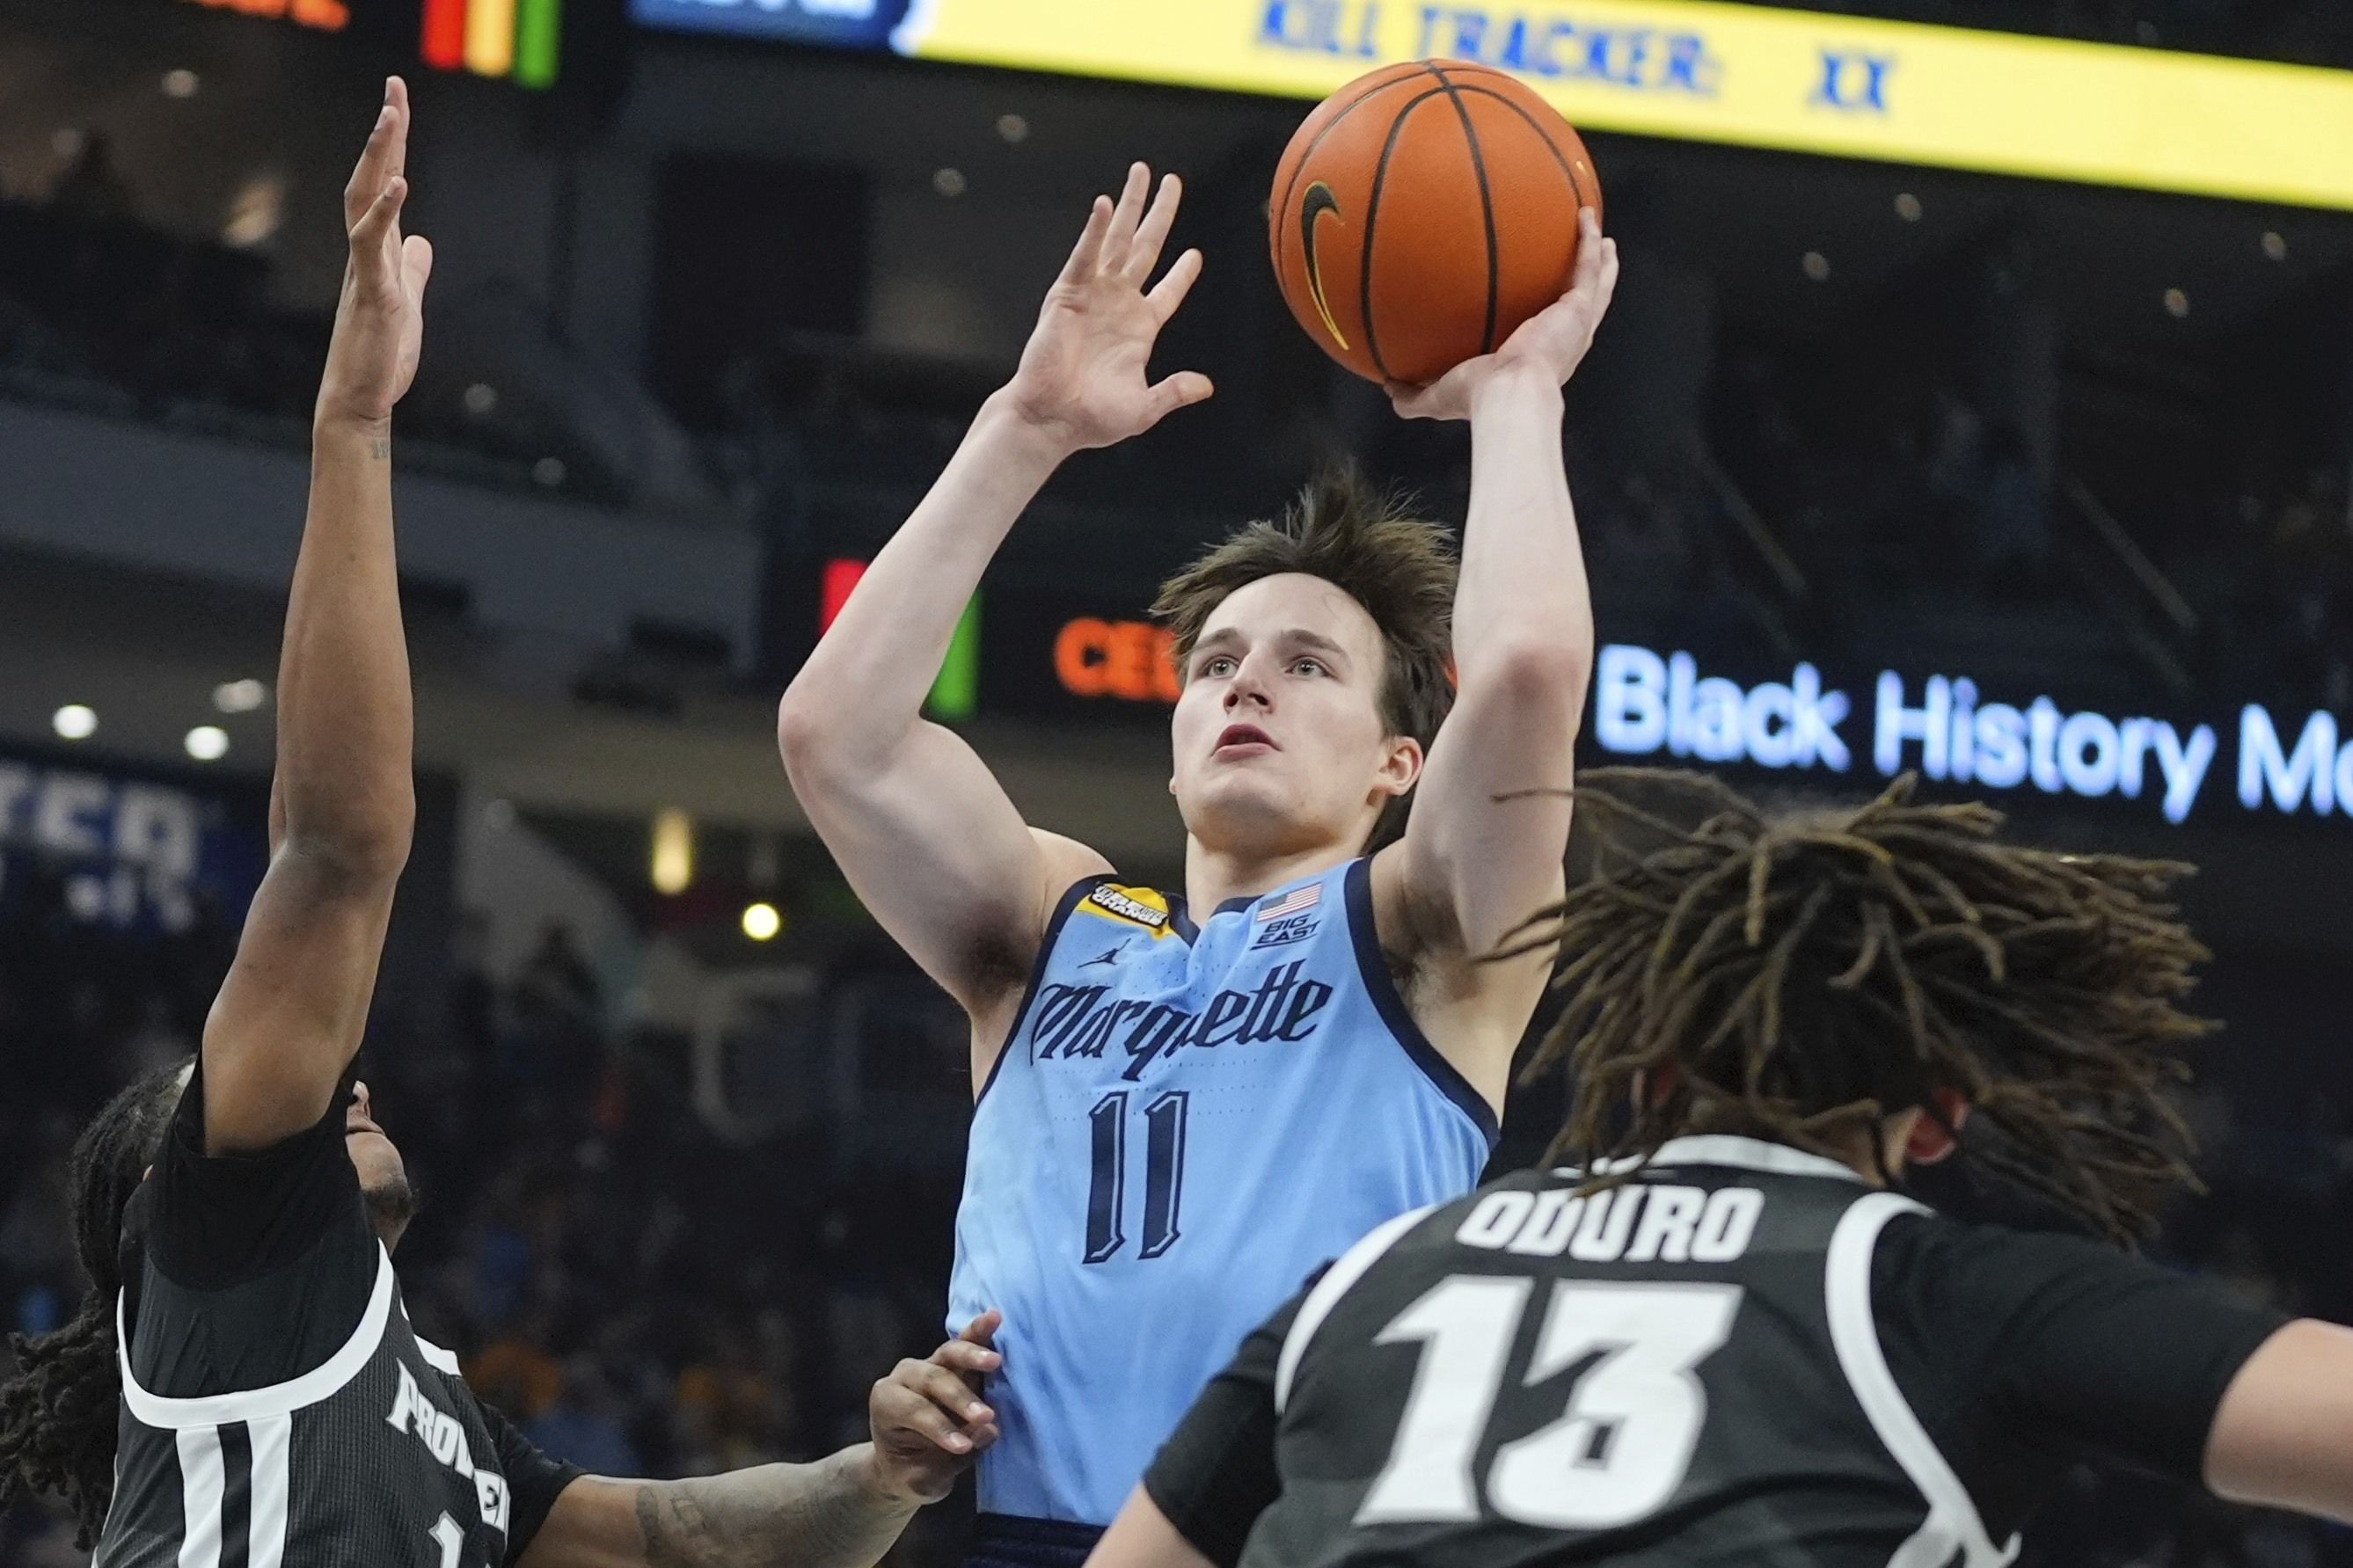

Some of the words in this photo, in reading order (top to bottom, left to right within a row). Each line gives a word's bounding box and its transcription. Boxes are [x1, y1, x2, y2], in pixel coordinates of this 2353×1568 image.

[1595, 643, 1851, 772] Black
[1874, 668, 2217, 825] History
[1256, 920, 1322, 944] EAST
[1264, 913, 1312, 933] BIG
[1030, 959, 1334, 1082] Marquette
[1082, 1090, 1190, 1265] 11
[1455, 1184, 1765, 1263] ODURO
[1351, 1273, 1746, 1530] 13
